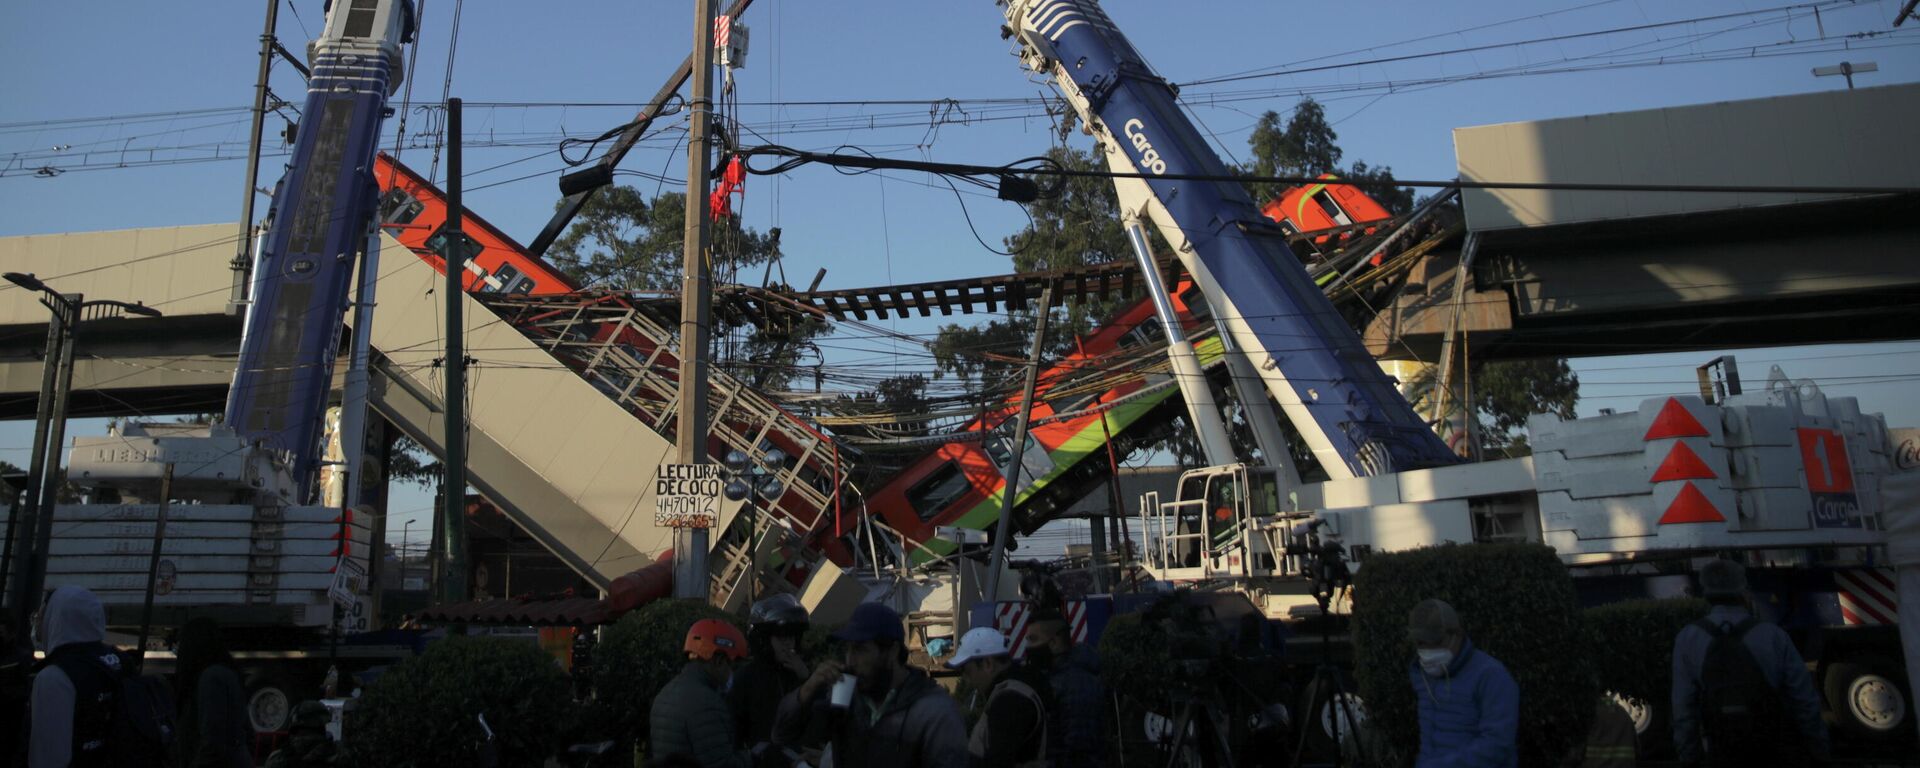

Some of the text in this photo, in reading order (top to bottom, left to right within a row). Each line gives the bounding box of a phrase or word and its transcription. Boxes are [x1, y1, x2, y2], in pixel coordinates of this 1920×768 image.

[1125, 118, 1166, 175] Cargo
[656, 463, 719, 479] LECTURA
[1814, 434, 1834, 487] 1
[656, 496, 717, 513] 41470912
[1816, 496, 1856, 526] Cargo
